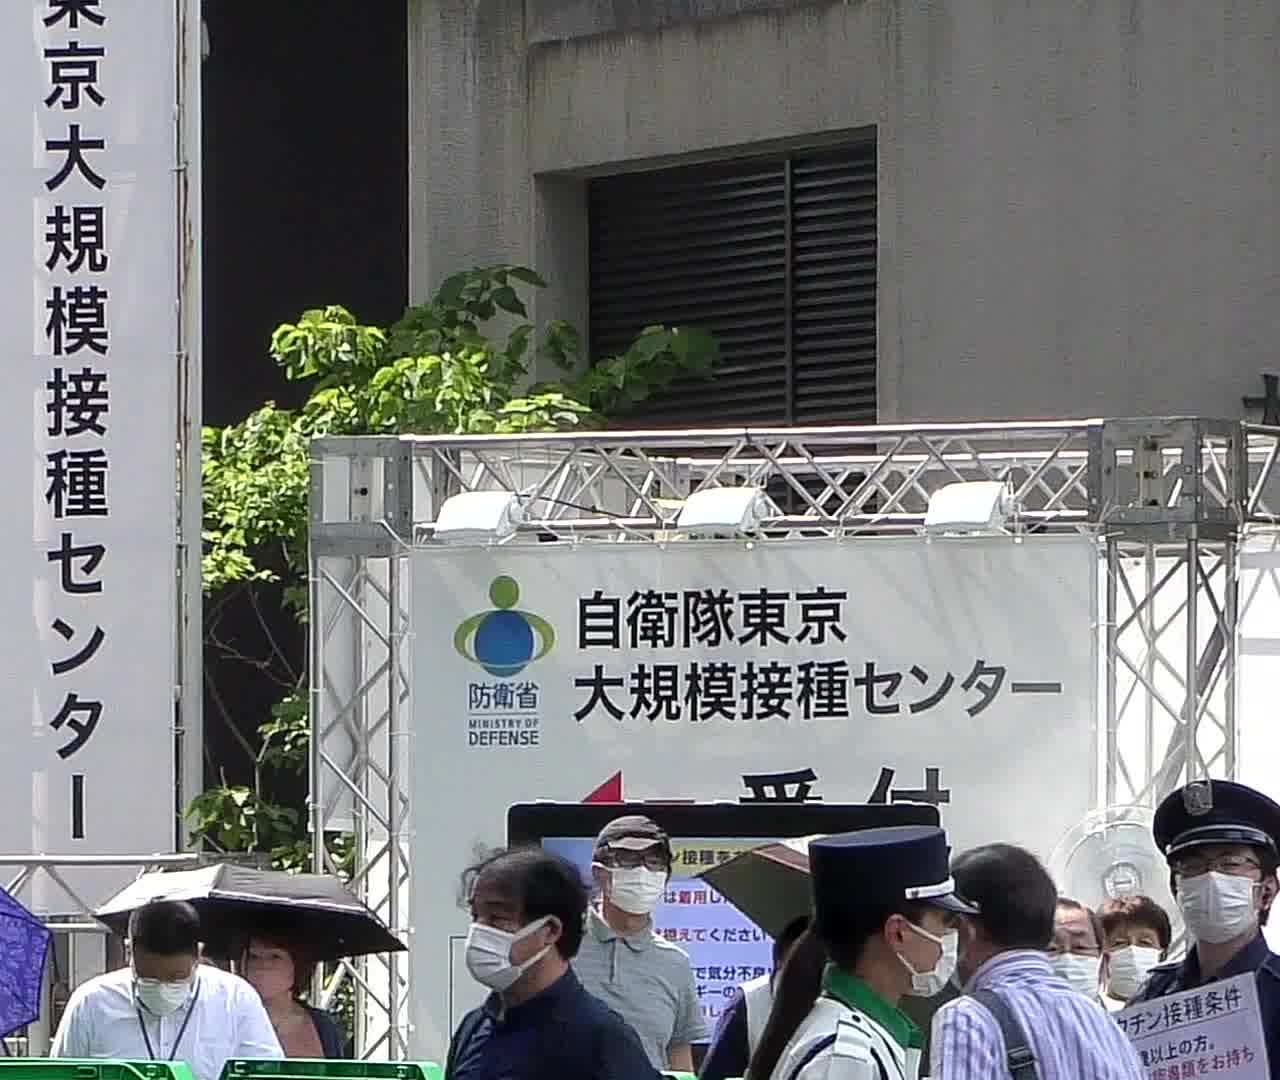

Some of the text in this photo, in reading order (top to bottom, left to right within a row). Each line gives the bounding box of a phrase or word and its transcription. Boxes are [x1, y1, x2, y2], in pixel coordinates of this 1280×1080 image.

[577, 586, 848, 650] 自衛隊東京
[468, 682, 540, 710] 防衛省
[573, 658, 1062, 722] 大規模接種センター
[468, 719, 539, 729] MINISTRY OF
[468, 730, 540, 746] DEFENSE
